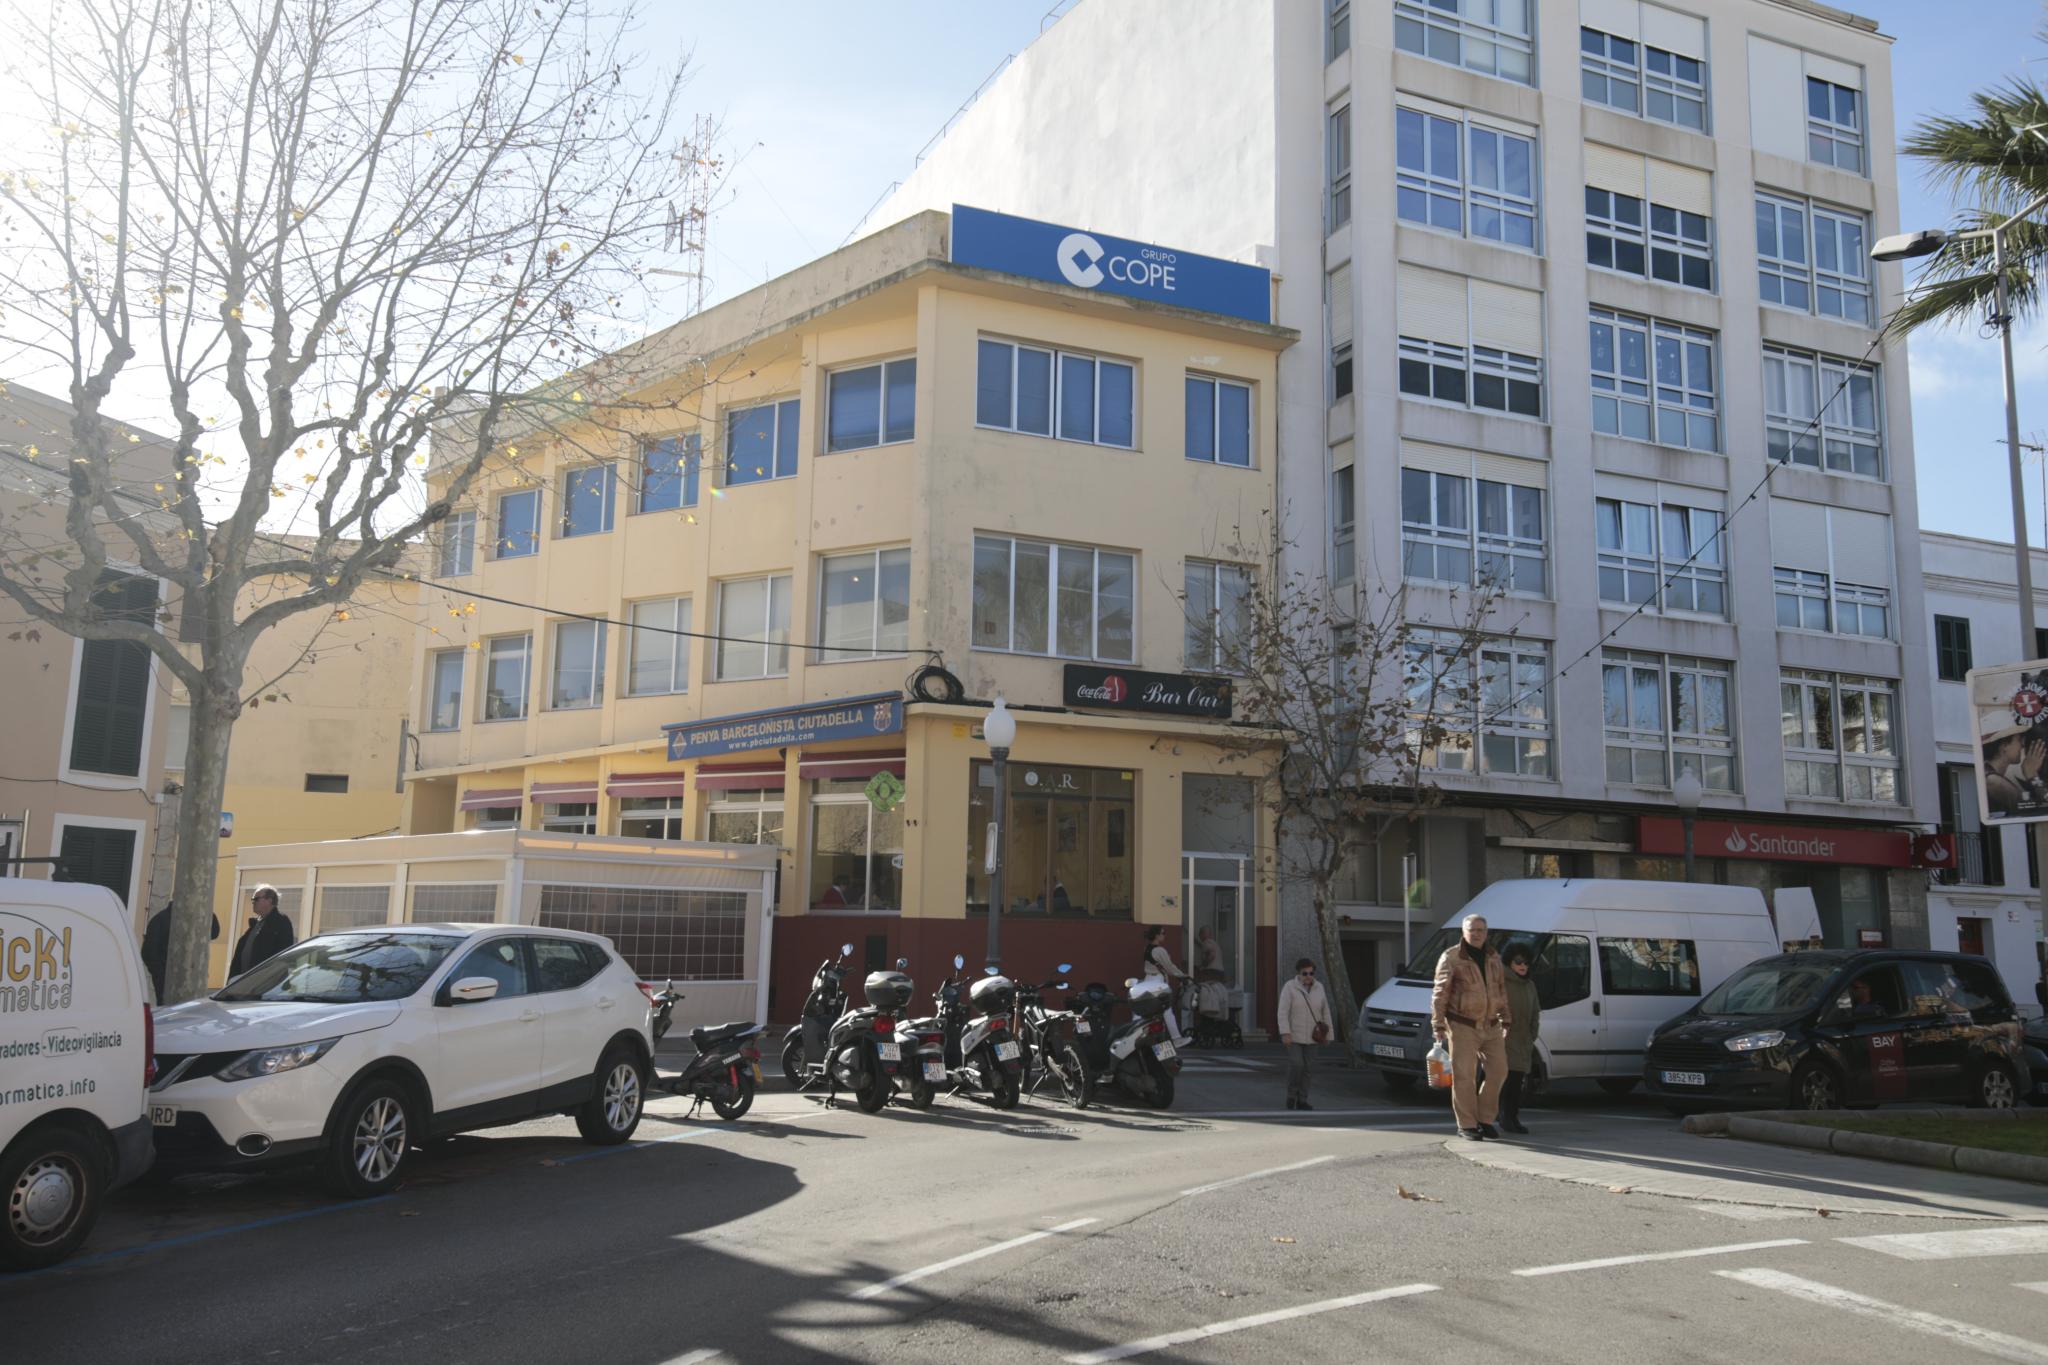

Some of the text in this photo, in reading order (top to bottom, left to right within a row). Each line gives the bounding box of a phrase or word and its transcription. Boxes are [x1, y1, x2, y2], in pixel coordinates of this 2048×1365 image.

[1141, 248, 1176, 264] GRUPO
[1109, 256, 1175, 290] COPE
[1142, 682, 1181, 704] Bar
[690, 709, 863, 745] PENYA BARCELONISTA CIUTADELLA
[728, 732, 815, 750] www.pbciutadella.com
[1749, 832, 1838, 857] Santander
[1872, 1035, 1896, 1048] BAY
[1667, 1072, 1686, 1083] 3852
